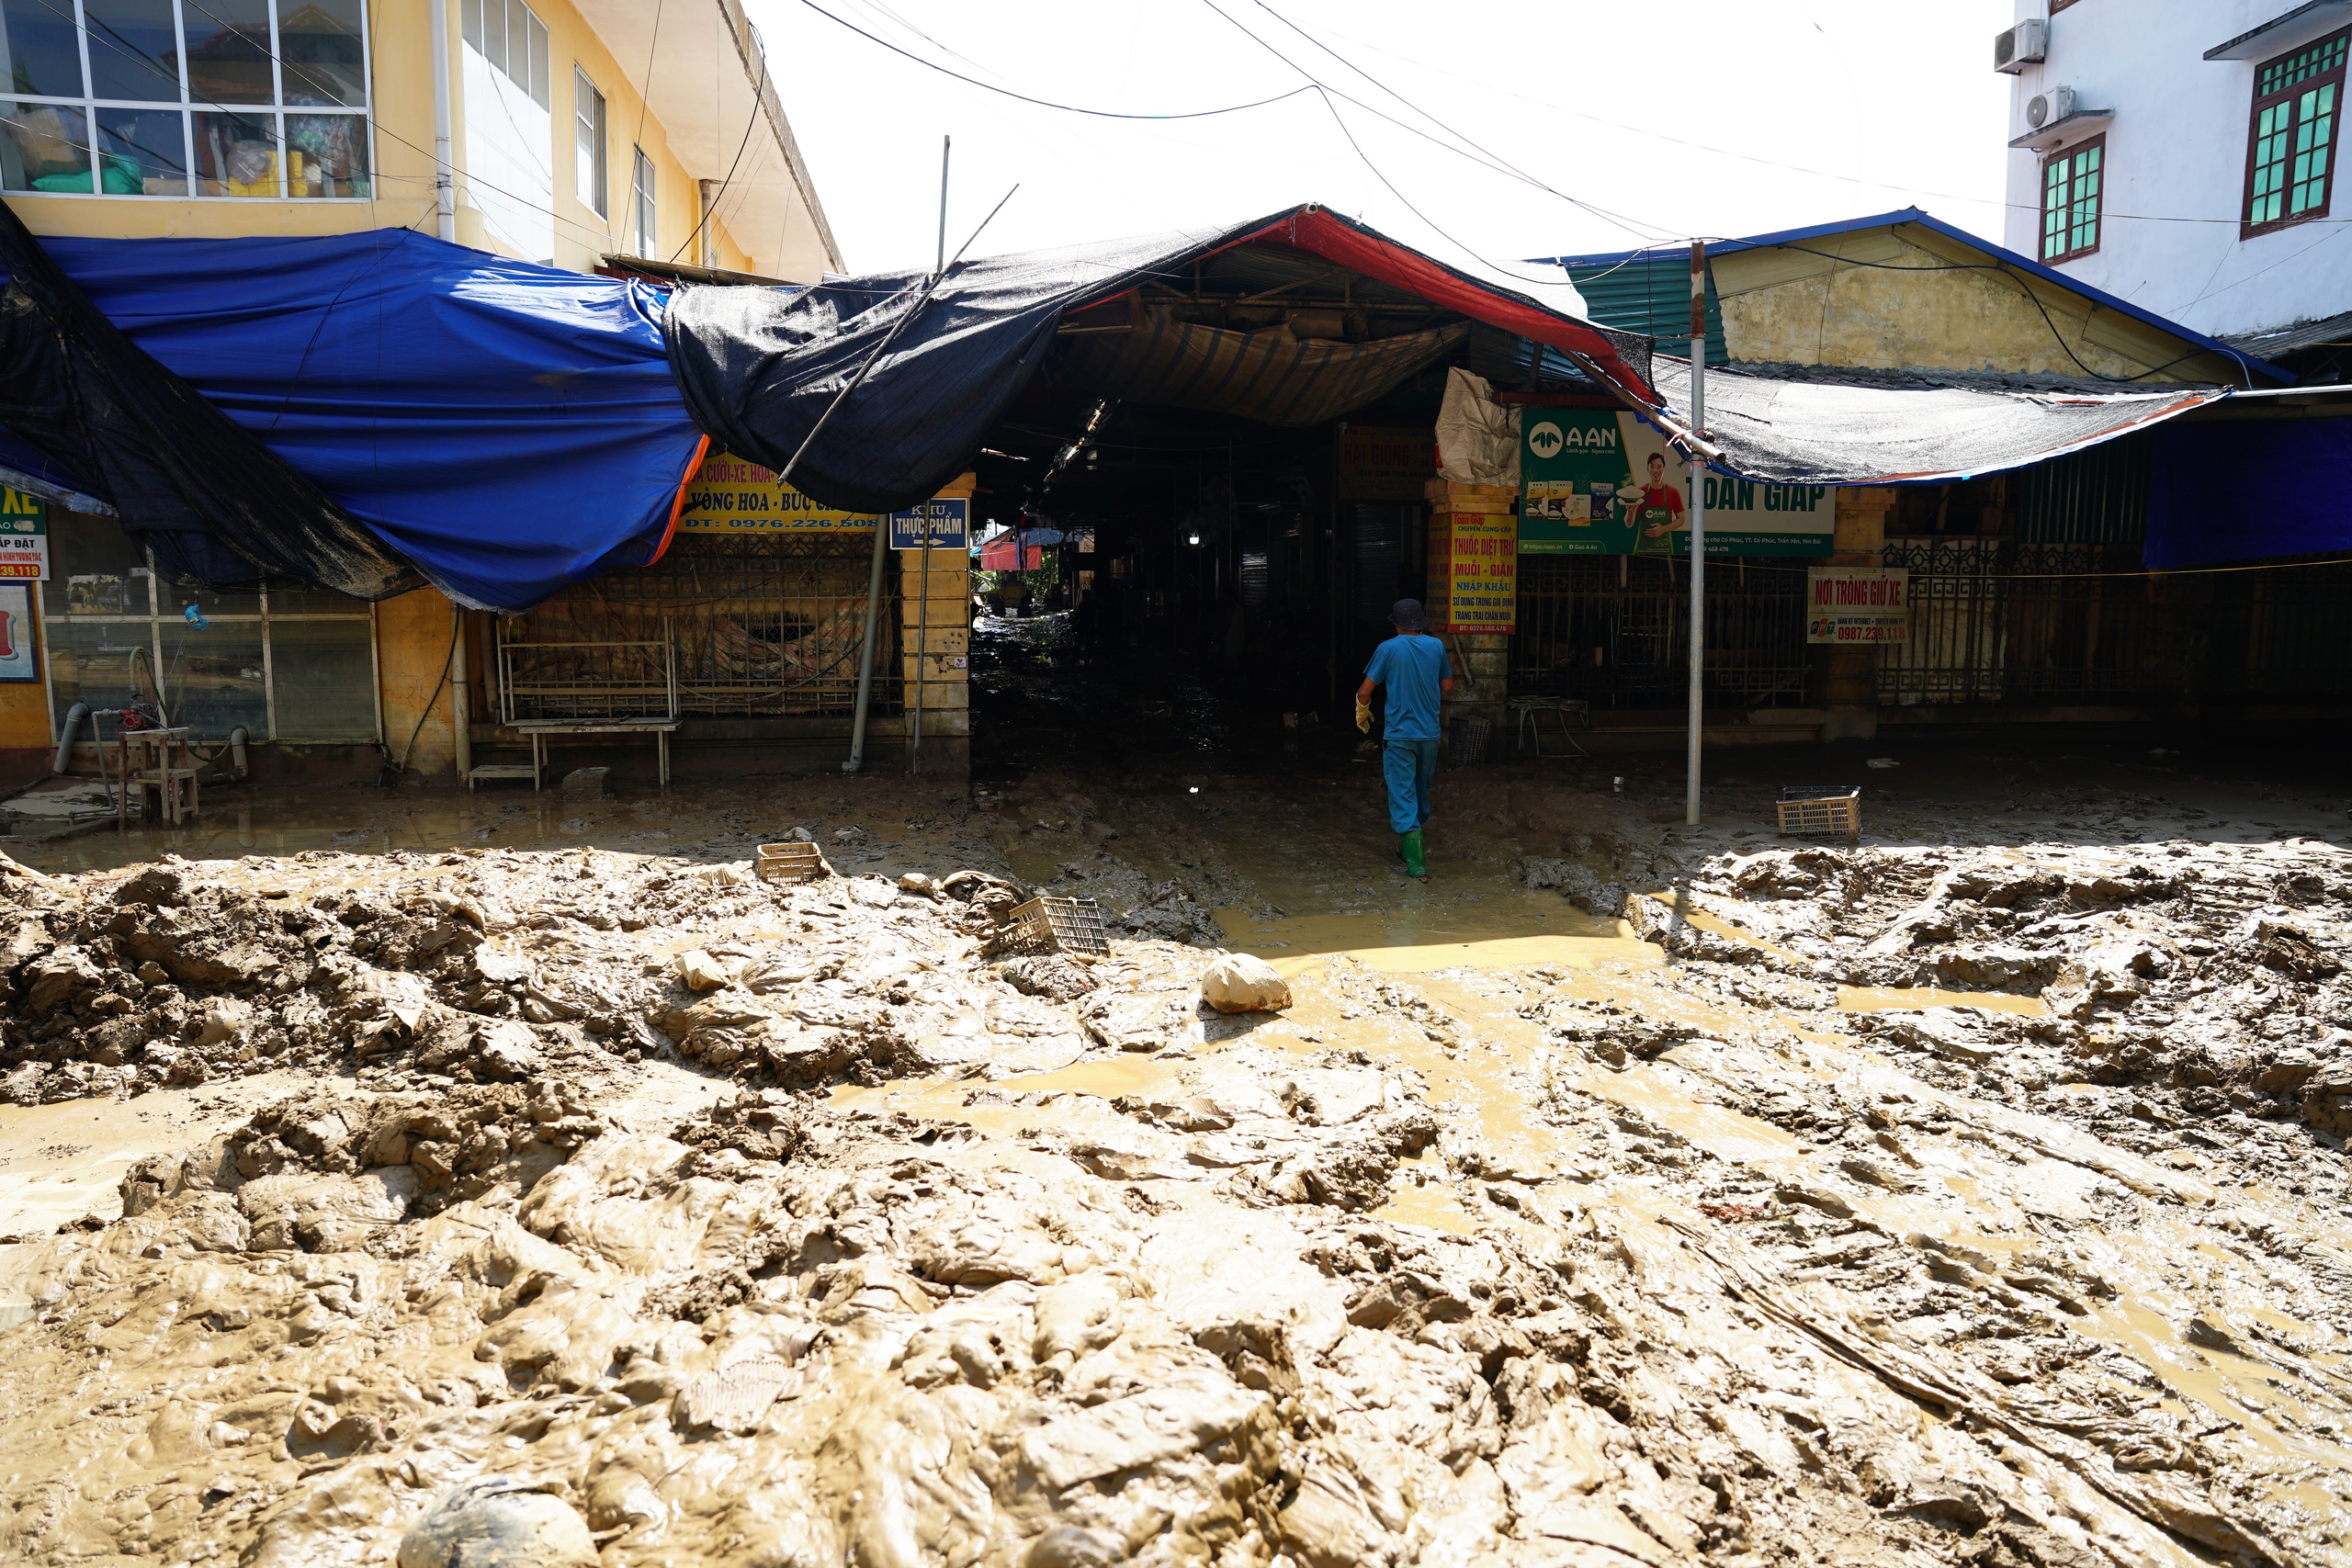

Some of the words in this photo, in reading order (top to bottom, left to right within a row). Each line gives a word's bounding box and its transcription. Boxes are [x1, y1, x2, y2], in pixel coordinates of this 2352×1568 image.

[1344, 443, 1368, 469] HẠT
[1372, 437, 1409, 466] GIỐNG
[691, 487, 734, 511] VÒNG
[738, 492, 769, 511] HOA
[910, 504, 946, 515] KHU
[684, 518, 720, 527] ĐT:
[729, 518, 877, 528] 0976.226.508
[895, 516, 925, 537] THỰC
[929, 511, 962, 535] PHẨM
[1500, 525, 1512, 533] CẤP
[14, 538, 35, 550] ĐẶT
[1453, 533, 1479, 555] THUỐC
[1481, 535, 1498, 558] DIỆT
[1498, 535, 1515, 556] TRỪ
[0, 565, 39, 577] 39.118
[1454, 558, 1480, 576] MUỖI
[1490, 561, 1513, 577] GIÁN
[1456, 579, 1482, 592] NHẬP
[1815, 578, 1833, 605] NƠI
[1836, 574, 1868, 605] TRÔNG
[1871, 574, 1889, 606] GIỮ
[1889, 581, 1902, 606] XE
[1453, 592, 1461, 606] SỬ
[1461, 596, 1475, 608] DỤNG
[1476, 597, 1492, 607] TRONG
[1493, 597, 1501, 607] GIA
[1455, 611, 1472, 621] TRANG
[1473, 611, 1484, 622] TRẠI
[1485, 609, 1498, 621] CHĂN
[1499, 609, 1511, 621] NUÔI
[1810, 618, 1836, 637] FPT
[1838, 626, 1905, 640] 0987.239.118
